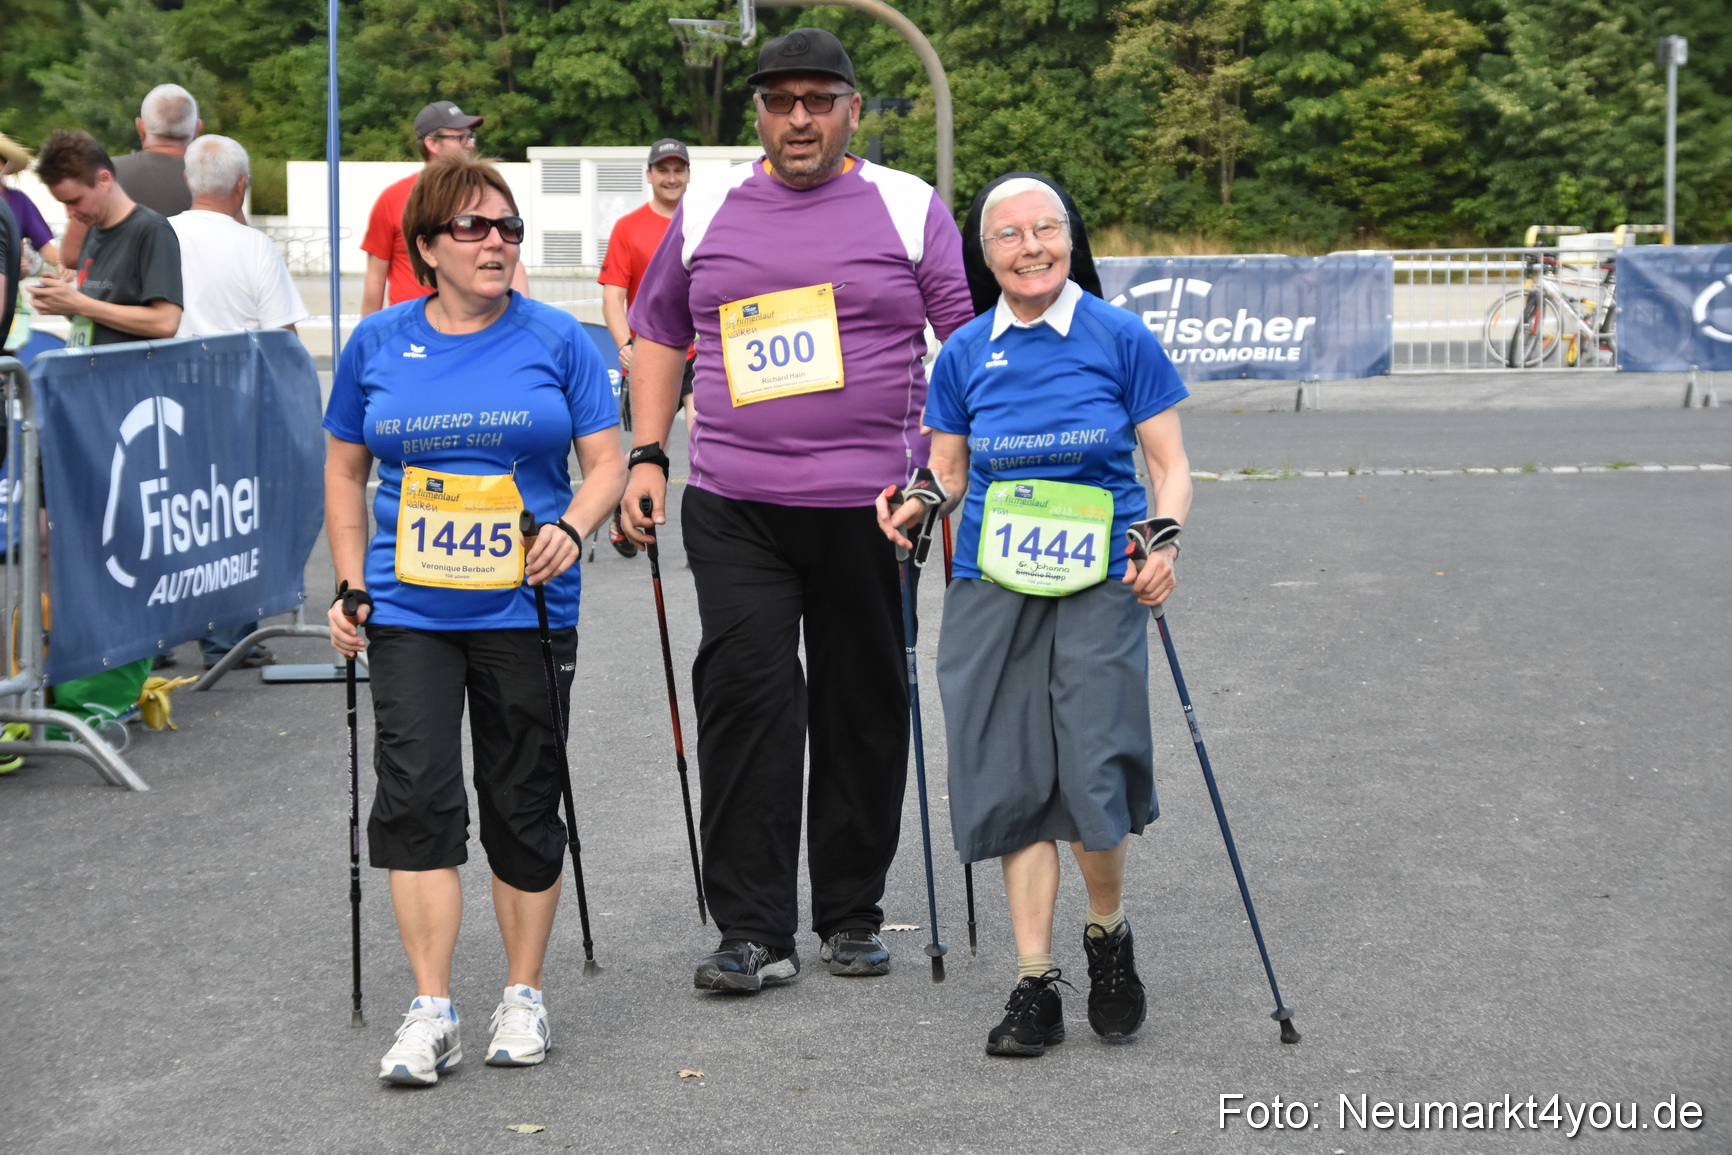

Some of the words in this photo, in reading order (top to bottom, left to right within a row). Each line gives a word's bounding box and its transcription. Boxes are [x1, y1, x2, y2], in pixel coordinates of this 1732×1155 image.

[1142, 308, 1316, 345] Fischer
[745, 330, 815, 373] 300
[761, 374, 789, 385] Richard
[789, 371, 806, 380] Hain
[375, 418, 401, 435] WER
[405, 412, 473, 433] LAUFEND
[479, 410, 533, 428] DENKT,
[402, 435, 460, 454] BEWEGT
[465, 432, 503, 447] SICH
[993, 433, 1056, 451] LAUFEND
[1060, 428, 1109, 446] DENKT,
[989, 454, 1044, 471] BEWEGT
[1048, 451, 1083, 465] SICH
[406, 499, 438, 513] walken
[418, 488, 460, 502] firmenlauf
[1005, 495, 1050, 508] firmenlauf
[411, 516, 513, 558] 1445
[996, 522, 1096, 568] 1444
[147, 547, 259, 607] AUTOMOBILE
[421, 561, 461, 573] Veronique
[462, 565, 496, 573] Berbach
[1030, 561, 1071, 573] Johanna
